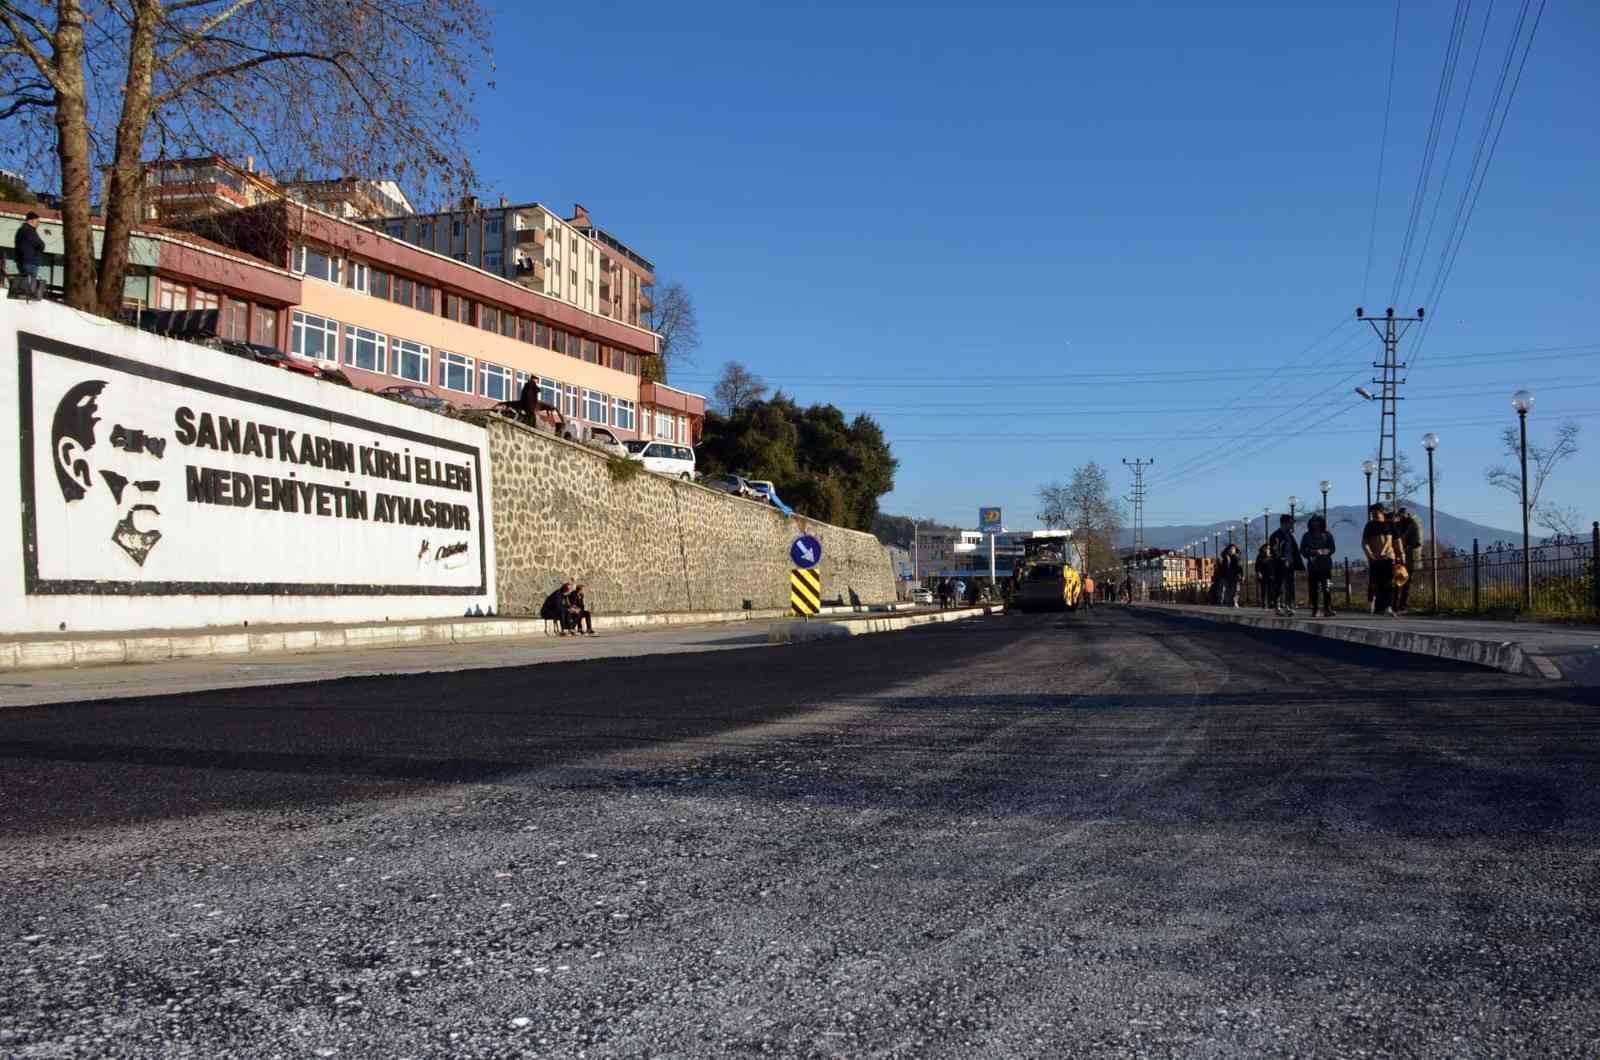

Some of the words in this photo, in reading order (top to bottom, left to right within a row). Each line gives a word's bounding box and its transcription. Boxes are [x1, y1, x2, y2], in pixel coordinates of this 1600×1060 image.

[175, 406, 355, 474] SANATKARIN
[359, 441, 412, 483] KİRLİ
[414, 461, 472, 493] ELLERİ
[185, 465, 368, 521] MEDENİYETİN
[373, 492, 471, 531] AYNASIDIR
